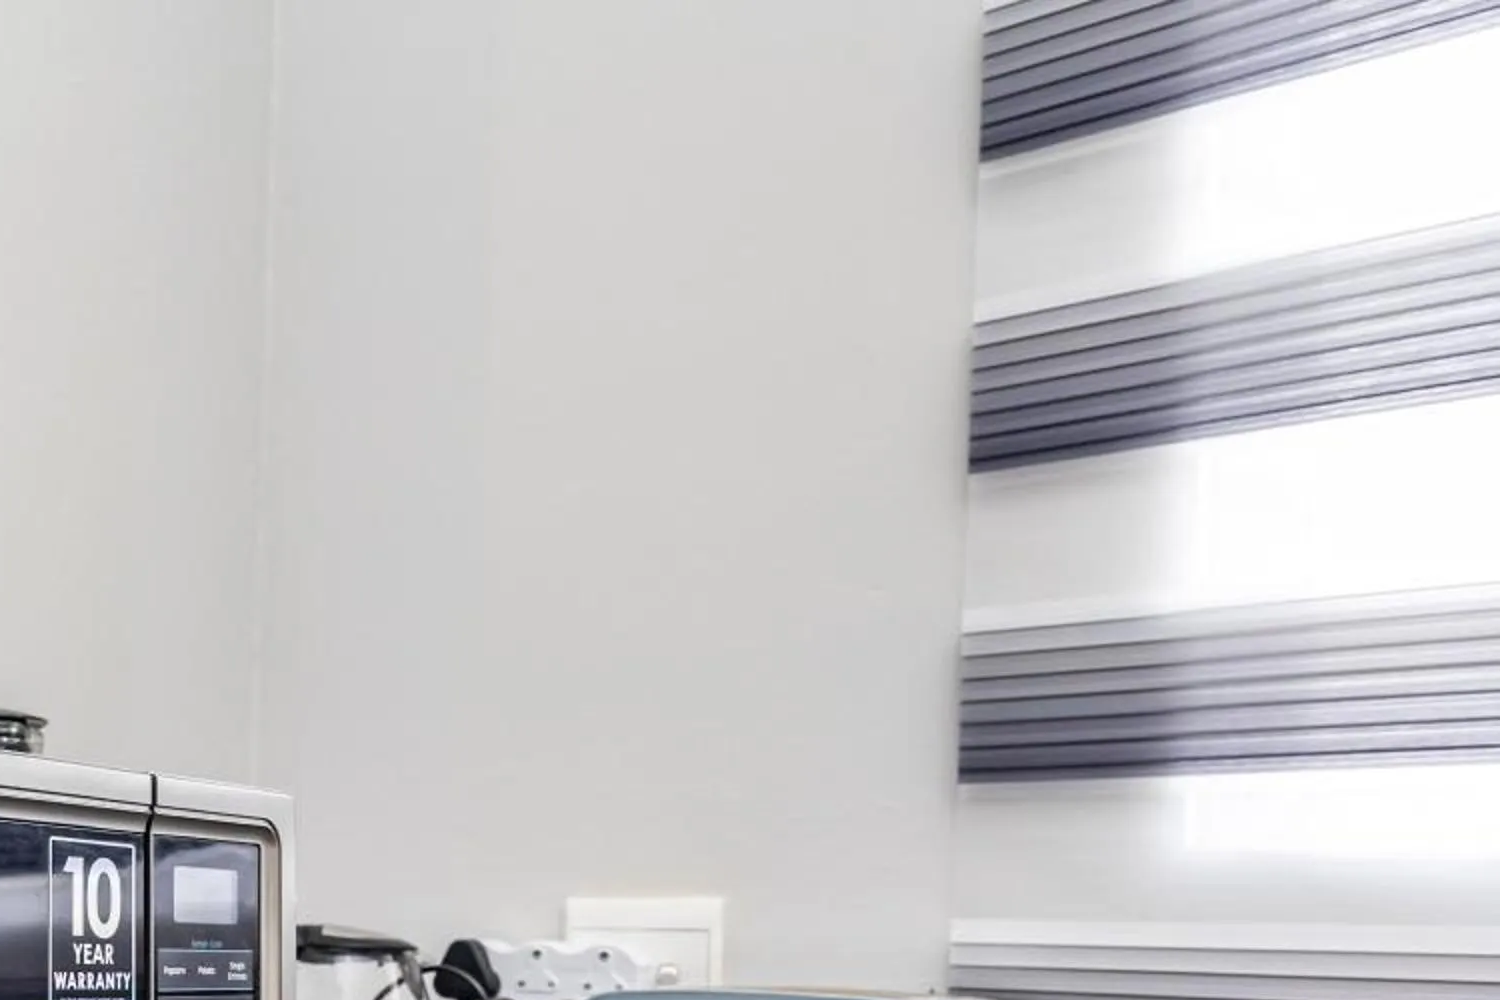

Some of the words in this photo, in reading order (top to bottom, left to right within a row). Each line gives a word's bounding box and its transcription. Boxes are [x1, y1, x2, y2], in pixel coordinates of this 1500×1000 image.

[63, 856, 121, 939] 10
[73, 942, 114, 965] YEAR
[54, 971, 131, 990] WARRANTY
